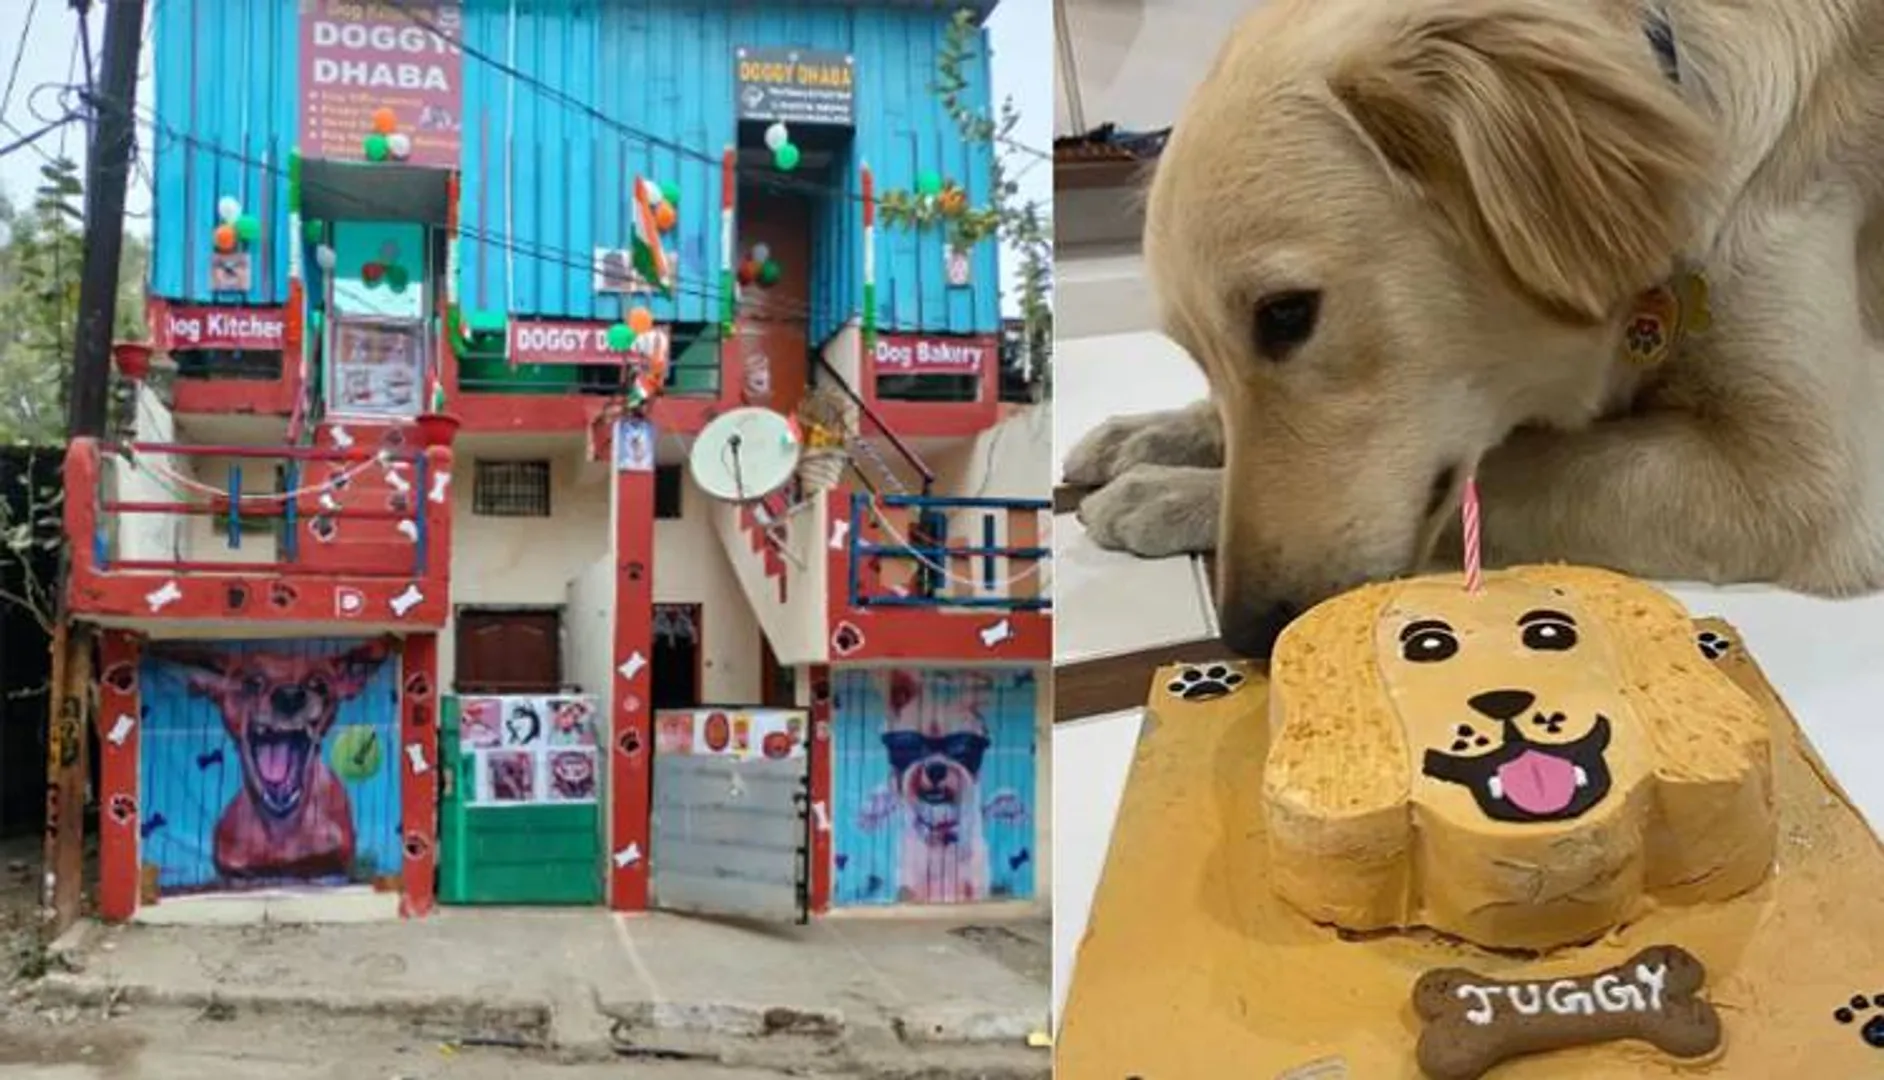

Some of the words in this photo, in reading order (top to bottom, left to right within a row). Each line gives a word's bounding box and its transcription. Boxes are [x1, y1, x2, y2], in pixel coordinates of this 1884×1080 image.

[313, 20, 453, 54] DOGGY
[313, 57, 448, 91] DHABA
[517, 326, 590, 351] DOGGY
[876, 341, 912, 368] Dog
[917, 341, 982, 369] Bakery
[1457, 963, 1667, 1025] JUGGY
